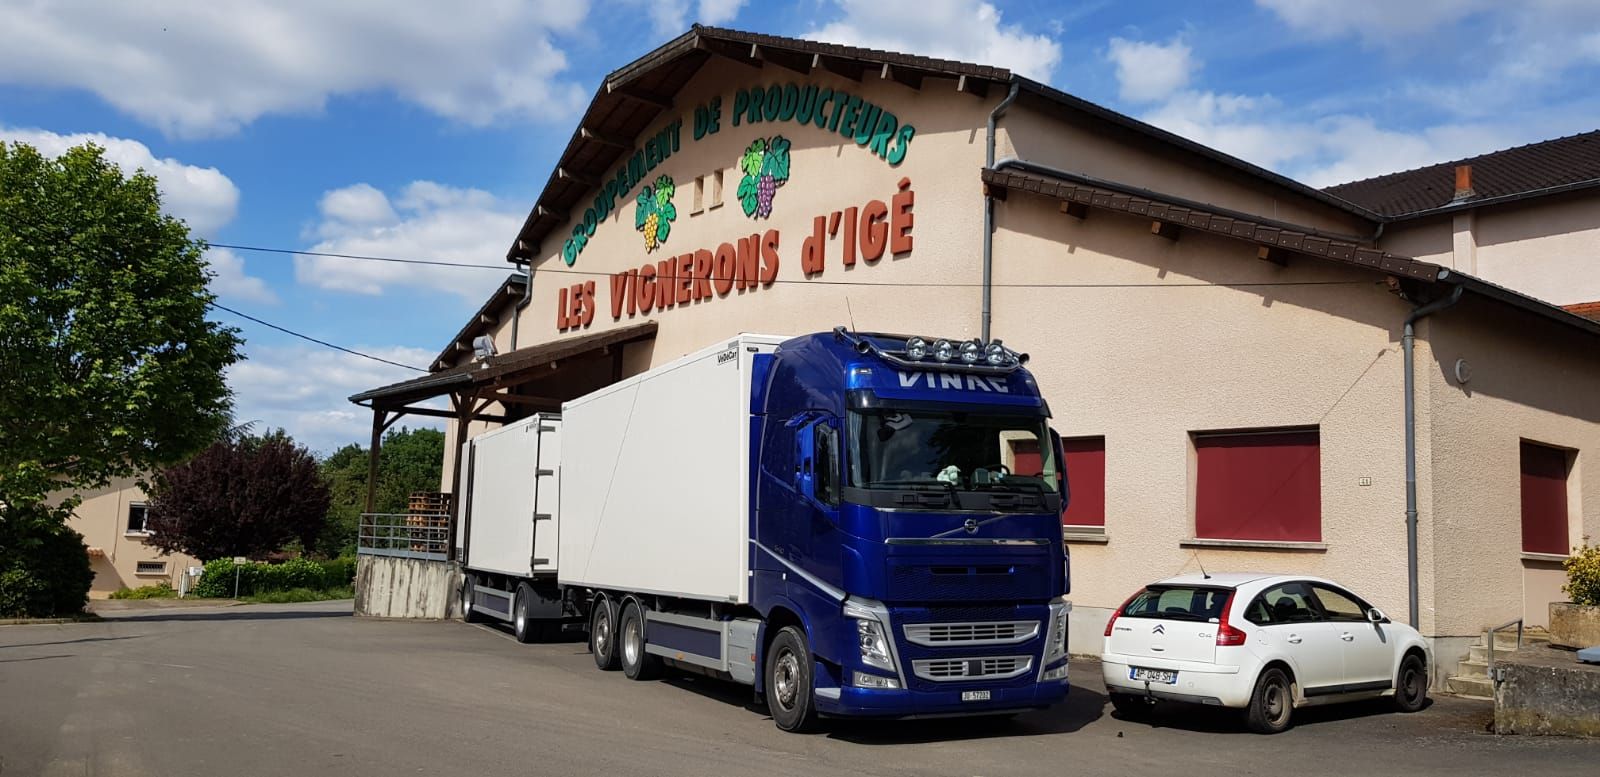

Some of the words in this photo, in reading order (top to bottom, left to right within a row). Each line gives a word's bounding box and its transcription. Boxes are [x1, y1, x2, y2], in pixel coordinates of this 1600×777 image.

[563, 118, 683, 267] GROUPEMENT
[693, 96, 721, 141] DE
[733, 82, 916, 166] PRODUCTEURS
[557, 280, 596, 330] LES
[610, 229, 780, 318] VIGNERONS
[801, 176, 915, 276] d'IGÉ
[898, 372, 1009, 393] VINAC
